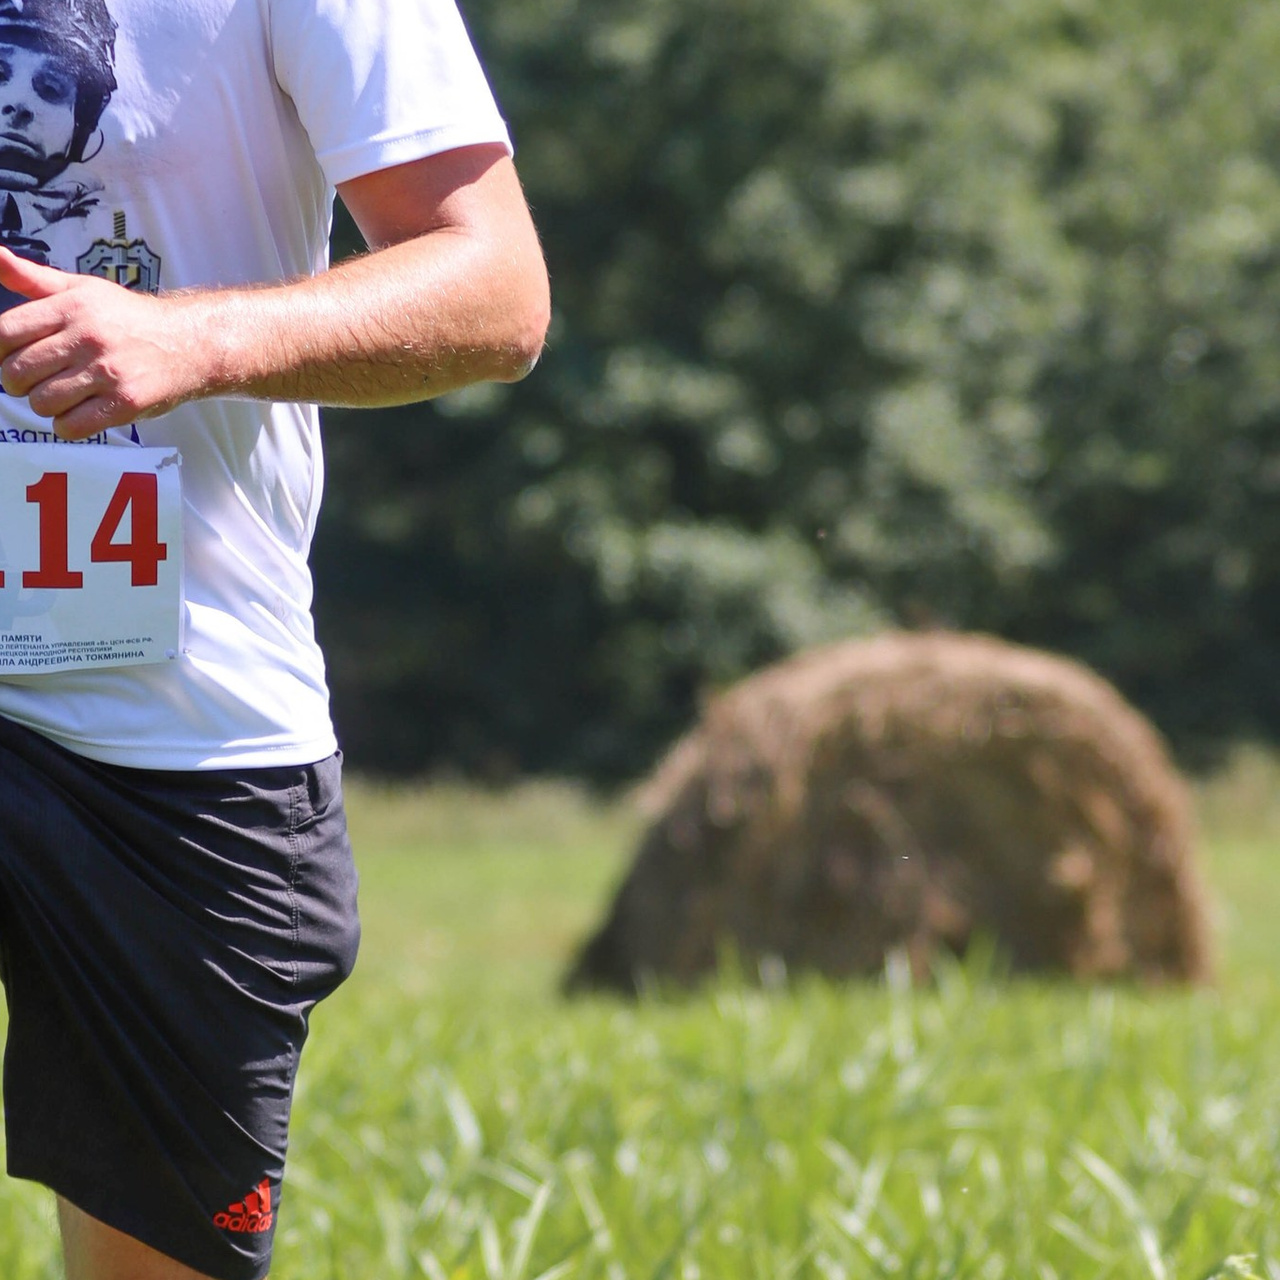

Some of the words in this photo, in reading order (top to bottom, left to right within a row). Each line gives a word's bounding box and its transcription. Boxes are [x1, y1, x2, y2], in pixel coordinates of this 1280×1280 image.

[1, 634, 42, 643] ПАМЯТИ
[51, 640, 96, 650] УПРАВЛЕНИЯ
[30, 648, 67, 657] НАРОДНОЙ
[67, 646, 113, 654] РЕСПУБЛИКИ
[17, 655, 83, 667] АНДРЕЕВИЧА
[85, 650, 145, 662] ТОКМЯНИНА
[213, 1211, 273, 1233] adidas
